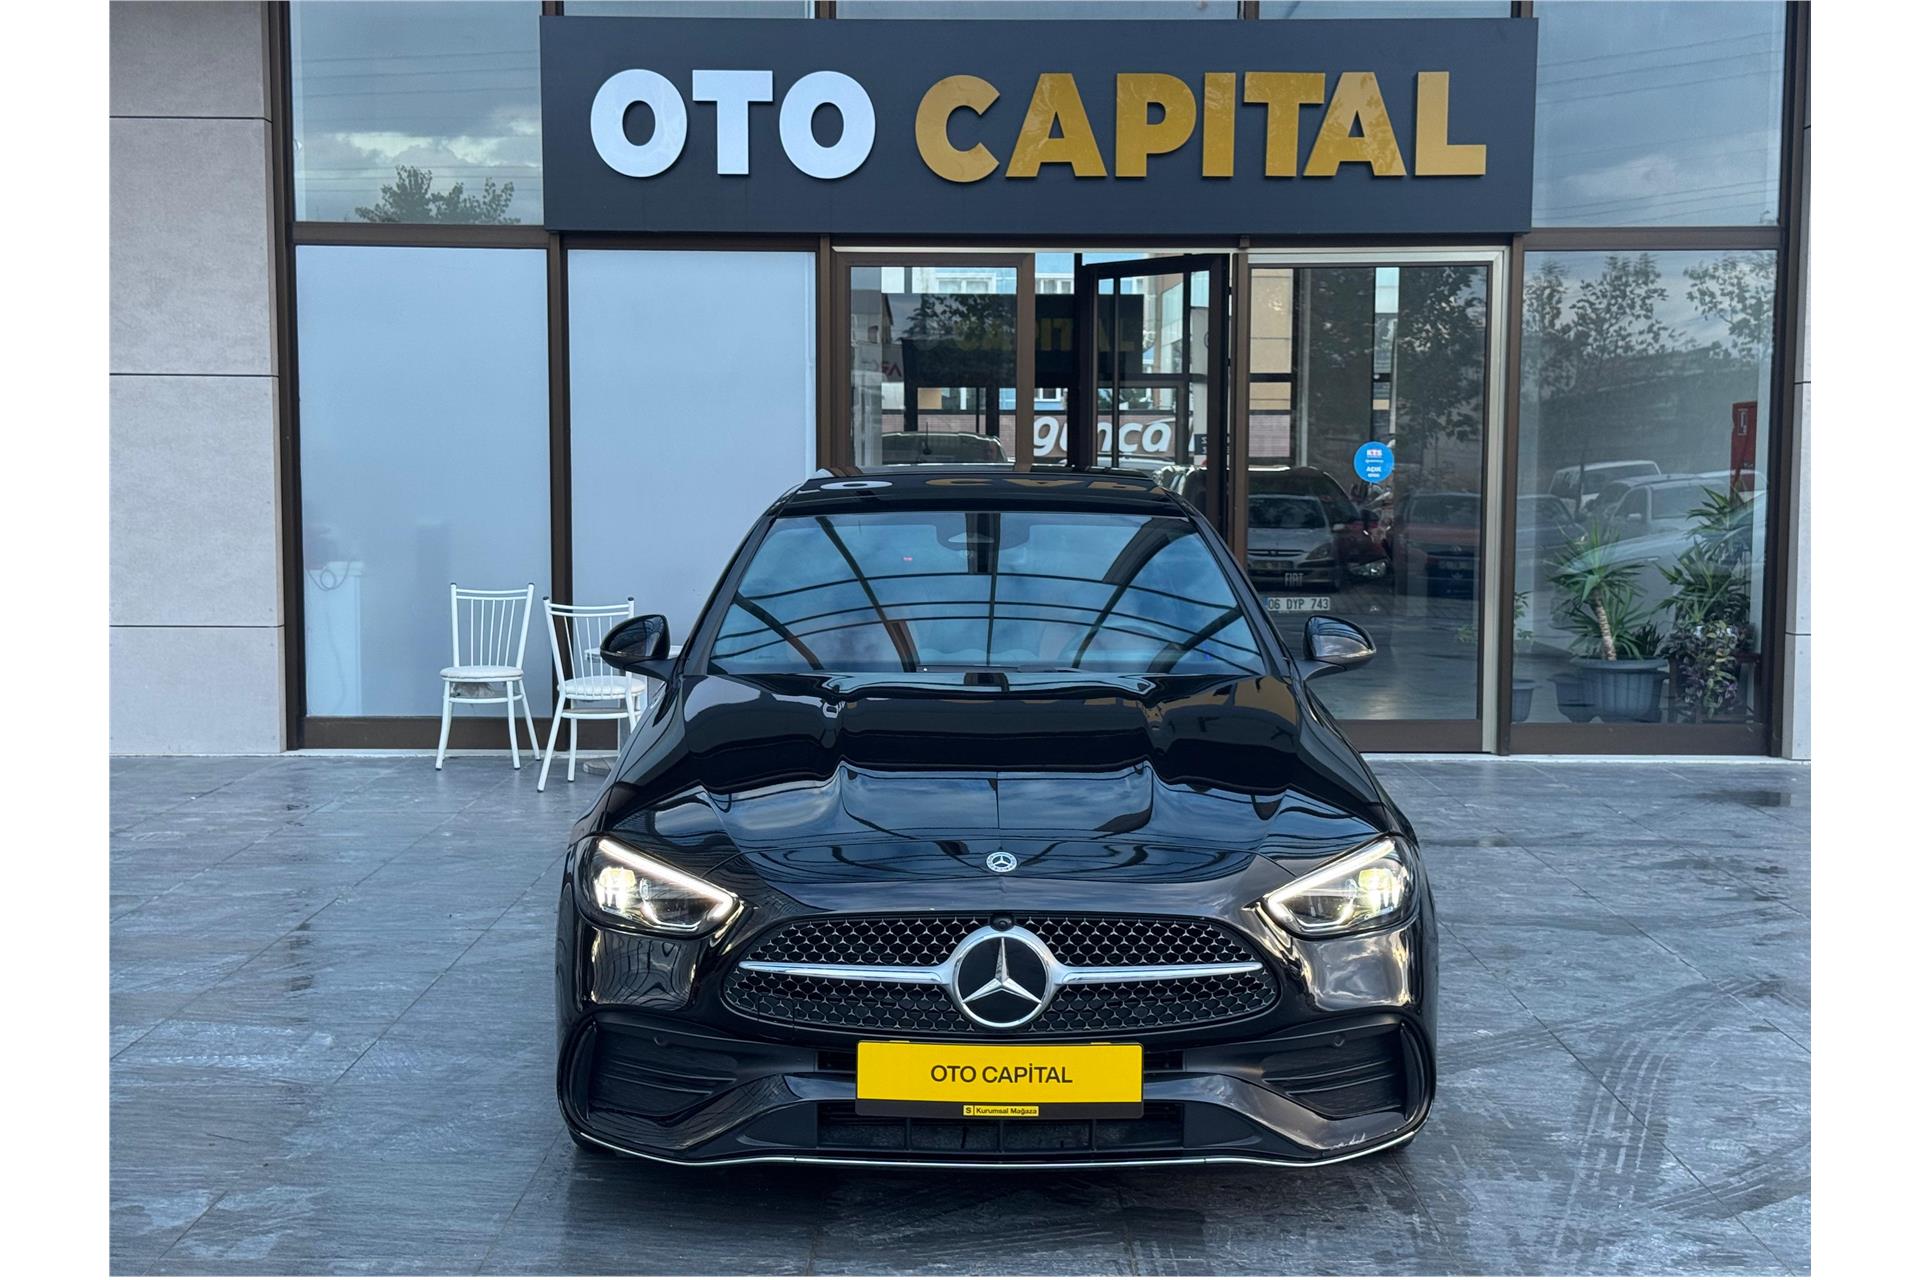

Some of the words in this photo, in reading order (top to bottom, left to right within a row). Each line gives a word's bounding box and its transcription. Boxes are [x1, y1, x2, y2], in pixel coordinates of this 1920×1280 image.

[590, 69, 877, 180] OTO
[917, 71, 1486, 182] CAPITAL
[1268, 598, 1281, 610] 06
[1286, 598, 1305, 610] DYP
[1311, 598, 1329, 610] 743
[930, 1065, 977, 1083] OTO
[981, 1062, 1073, 1084] CAPİTAL
[1010, 1107, 1038, 1116] Mağaza
